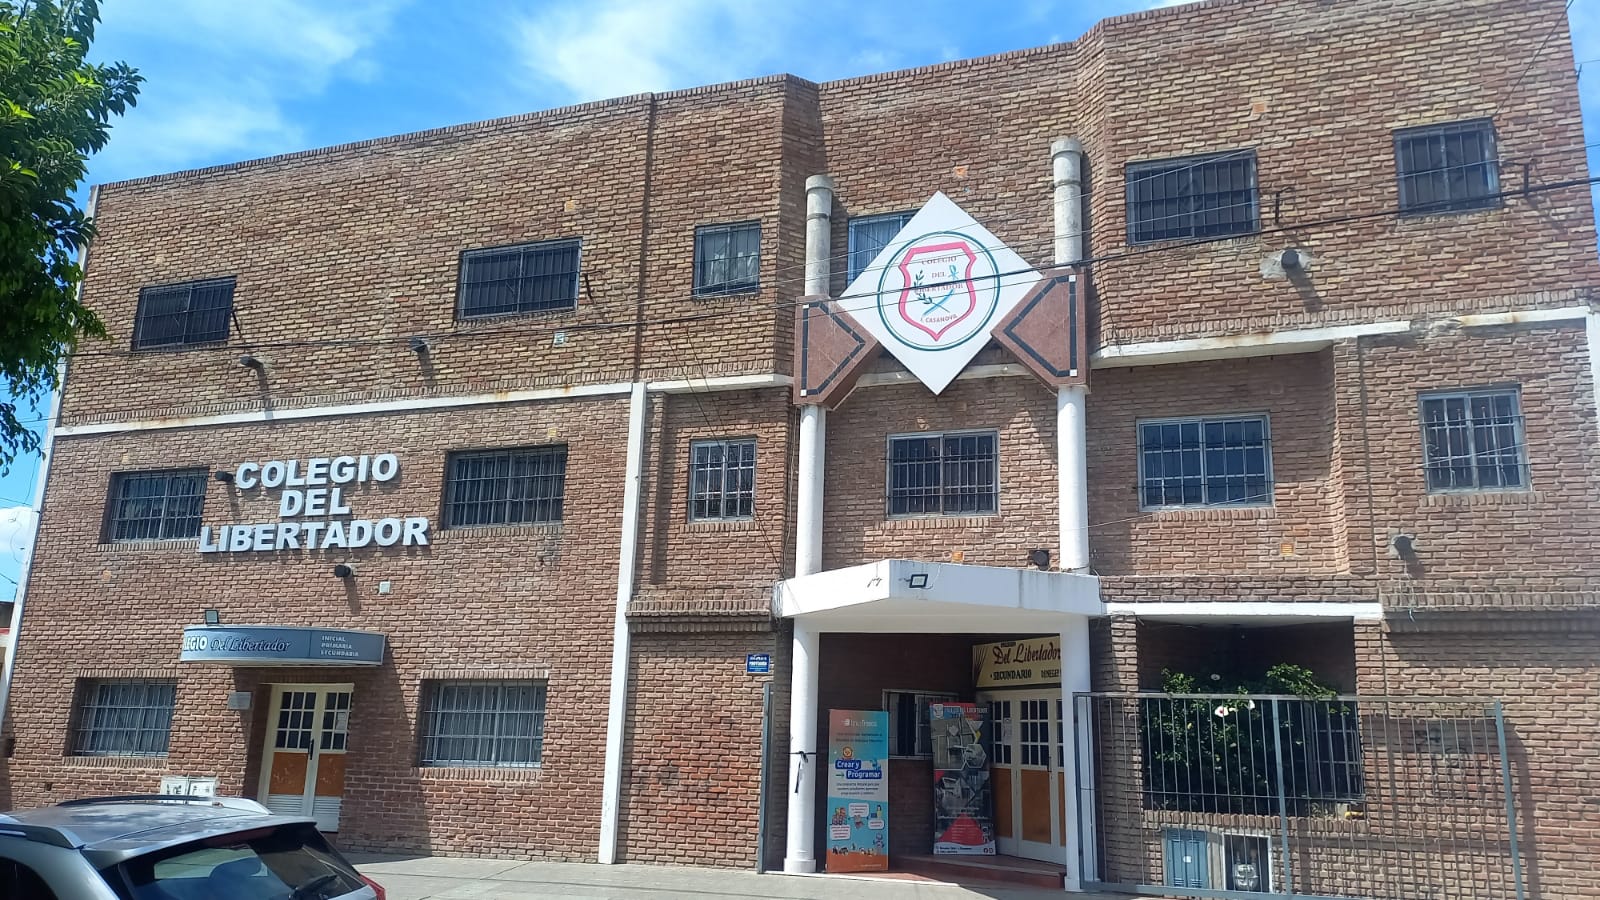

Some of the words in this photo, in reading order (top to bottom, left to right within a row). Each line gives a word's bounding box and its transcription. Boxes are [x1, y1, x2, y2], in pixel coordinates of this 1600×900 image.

[235, 453, 399, 489] COLEGIO
[279, 487, 351, 517] DEL
[199, 517, 430, 553] LIBERTADOR
[210, 636, 230, 651] Del
[229, 636, 290, 652] Libertador
[321, 642, 352, 650] PRIMARIA
[992, 645, 1011, 665] Del
[1013, 641, 1061, 664] Libertador
[992, 668, 1032, 681] SECUNDARIO
[836, 760, 854, 768] Crear
[847, 770, 881, 778] Programar
